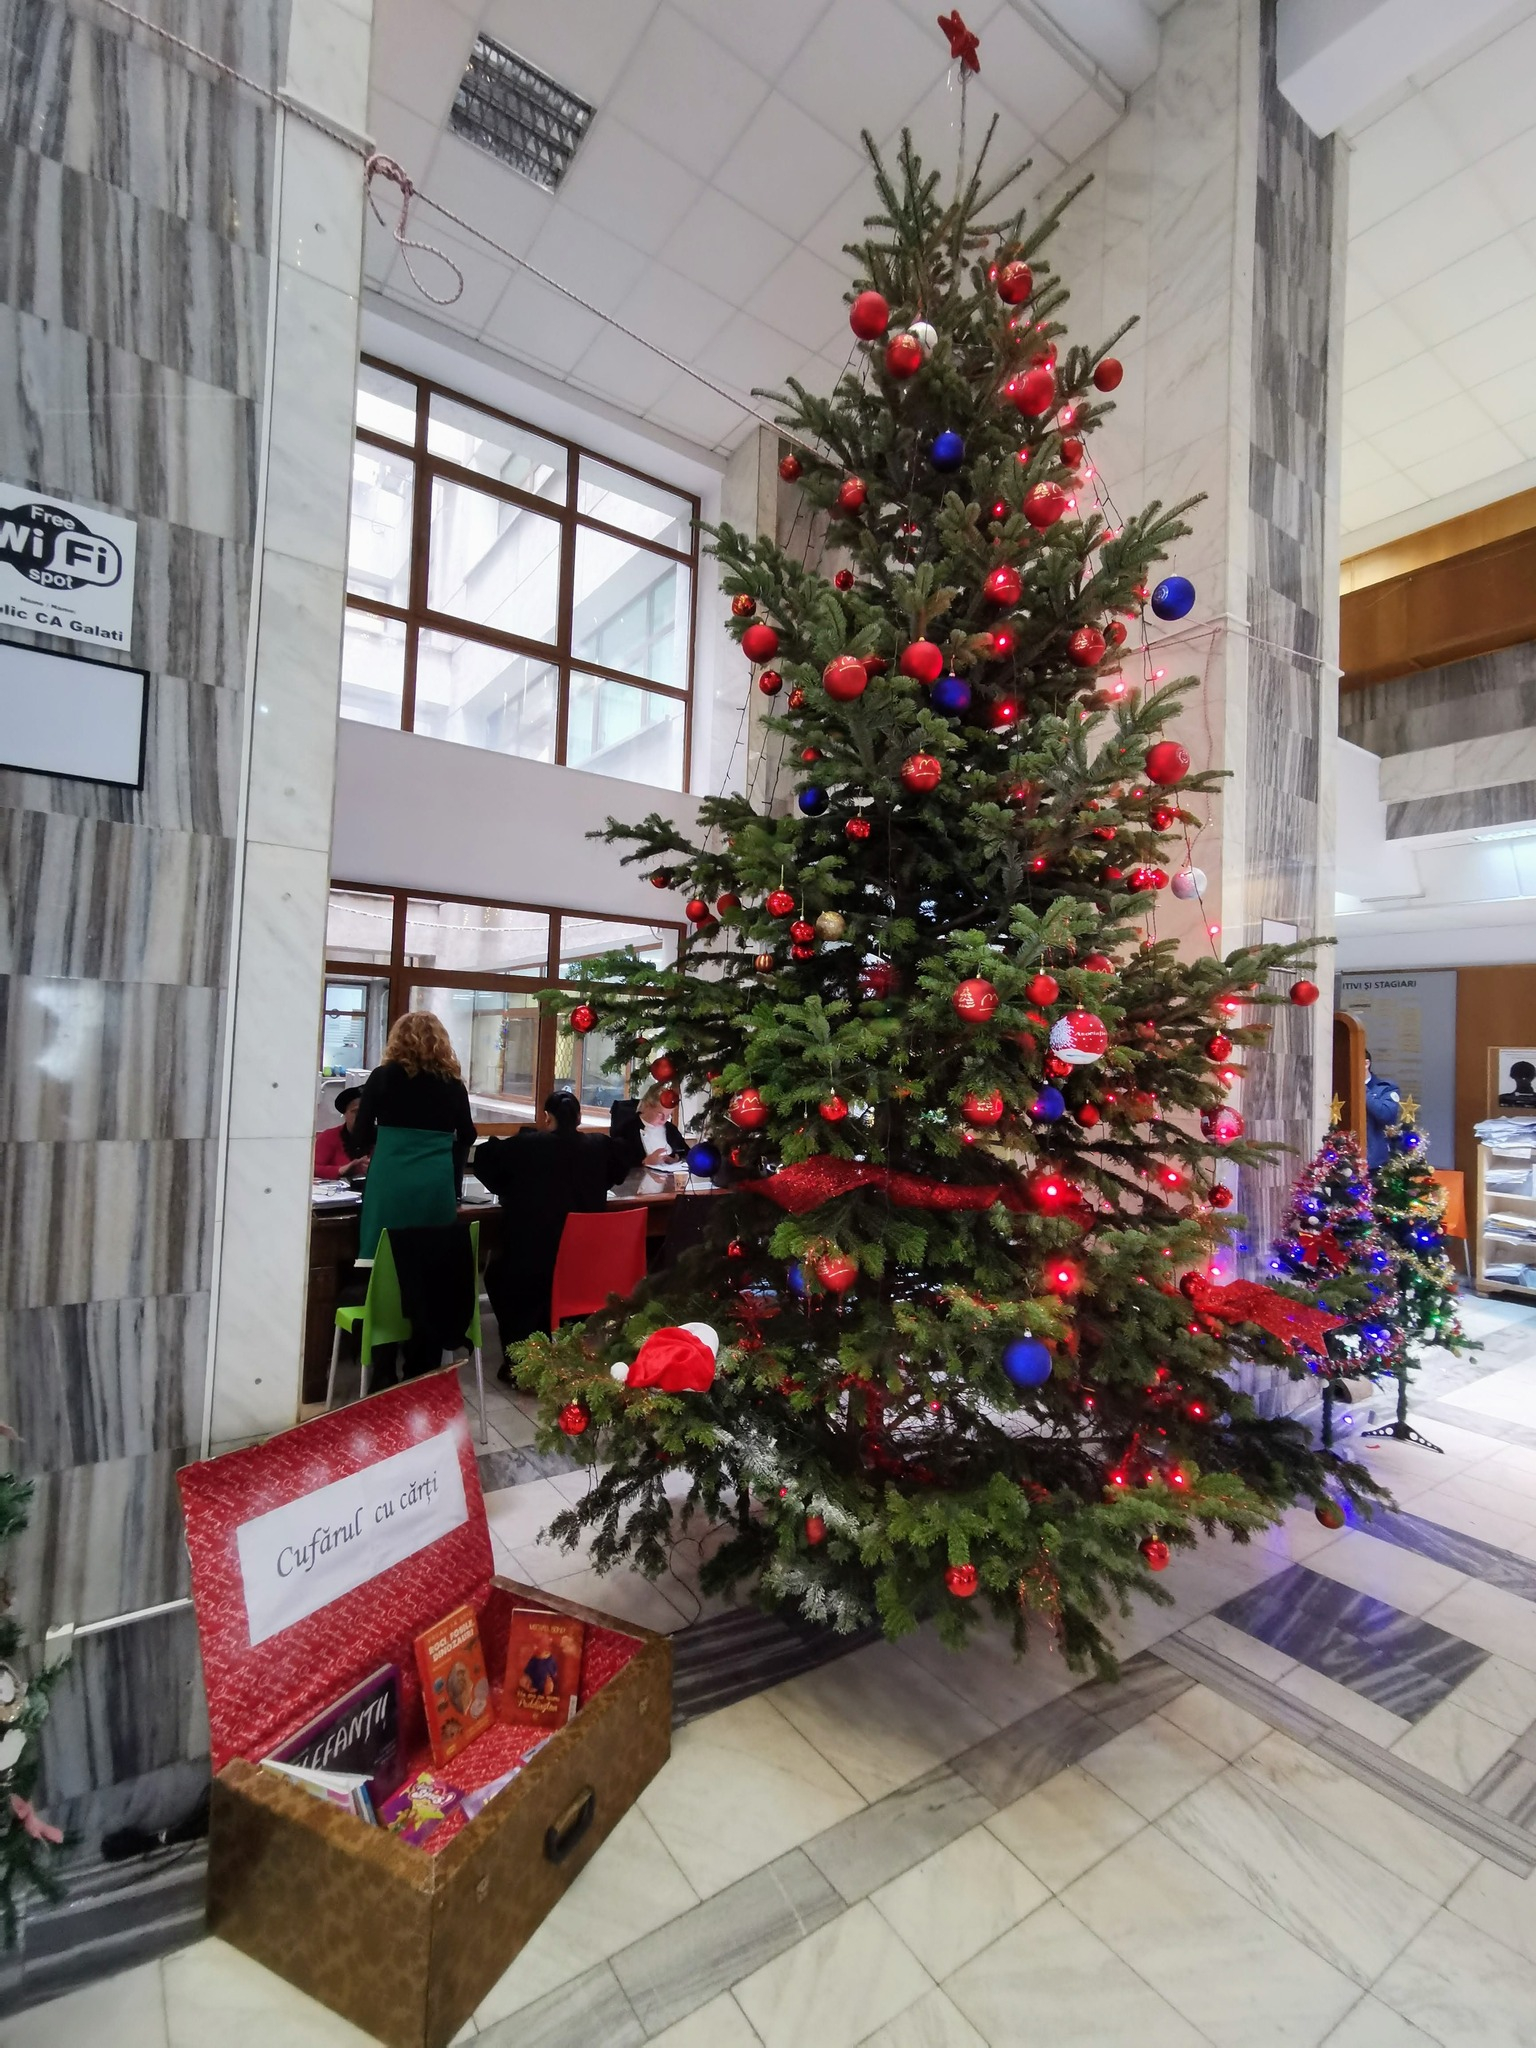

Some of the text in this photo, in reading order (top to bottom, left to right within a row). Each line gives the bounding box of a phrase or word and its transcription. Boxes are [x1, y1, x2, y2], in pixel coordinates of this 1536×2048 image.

[31, 505, 75, 530] Free
[29, 568, 73, 589] spot
[35, 612, 62, 628] CA
[70, 620, 123, 641] Galati
[1374, 980, 1417, 989] STAGIARI
[277, 1507, 363, 1577] Cufărul
[375, 1500, 394, 1523] cu
[400, 1471, 438, 1510] cărți
